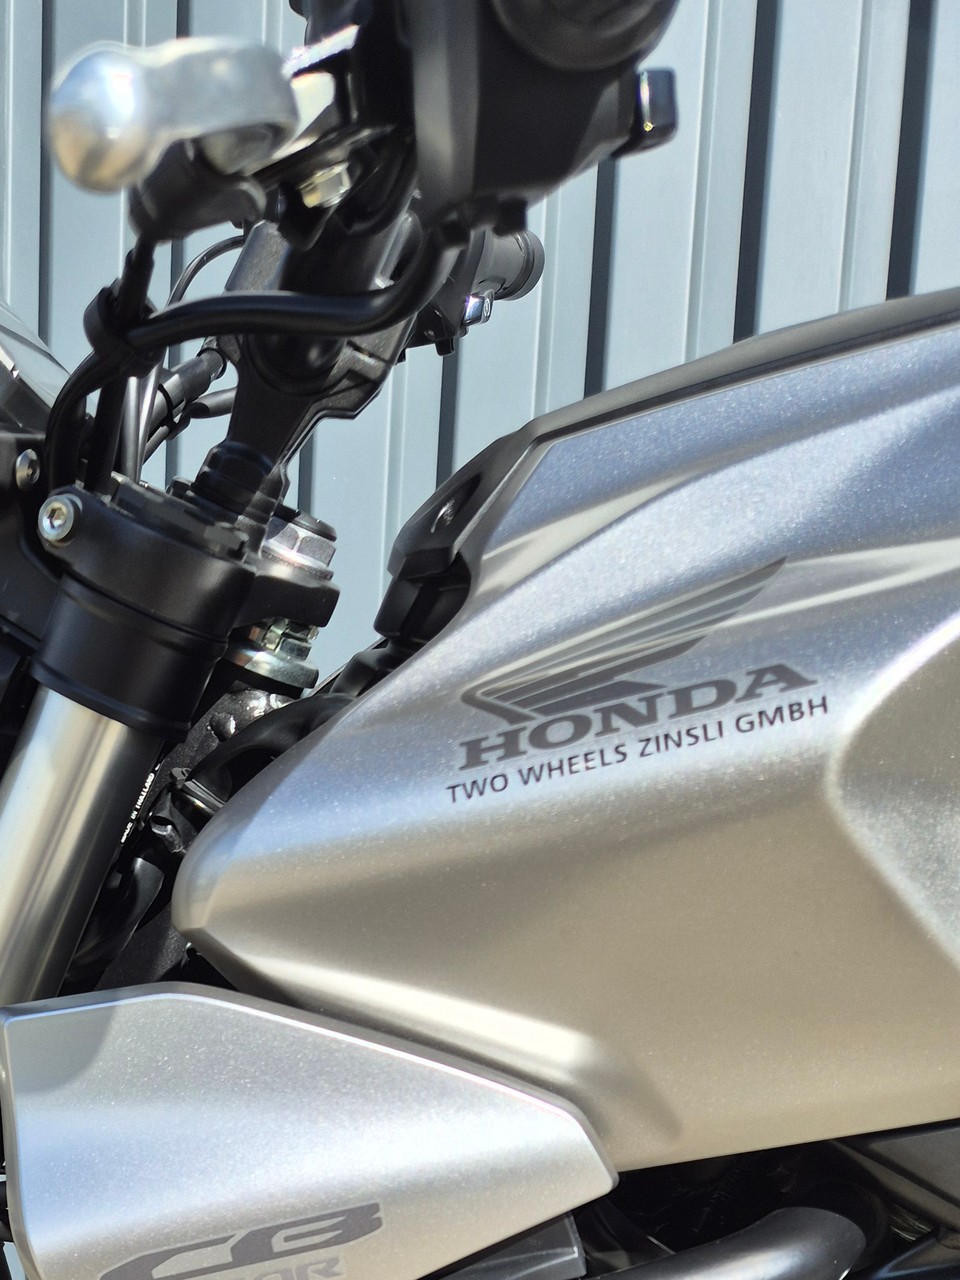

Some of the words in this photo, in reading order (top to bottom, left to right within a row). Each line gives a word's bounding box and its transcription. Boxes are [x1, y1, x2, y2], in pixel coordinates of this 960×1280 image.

[446, 774, 508, 804] TWO
[518, 744, 628, 786] WHEELS
[639, 720, 724, 758] ZINSLI
[735, 696, 829, 734] GMBH
[458, 664, 818, 771] HONDA
